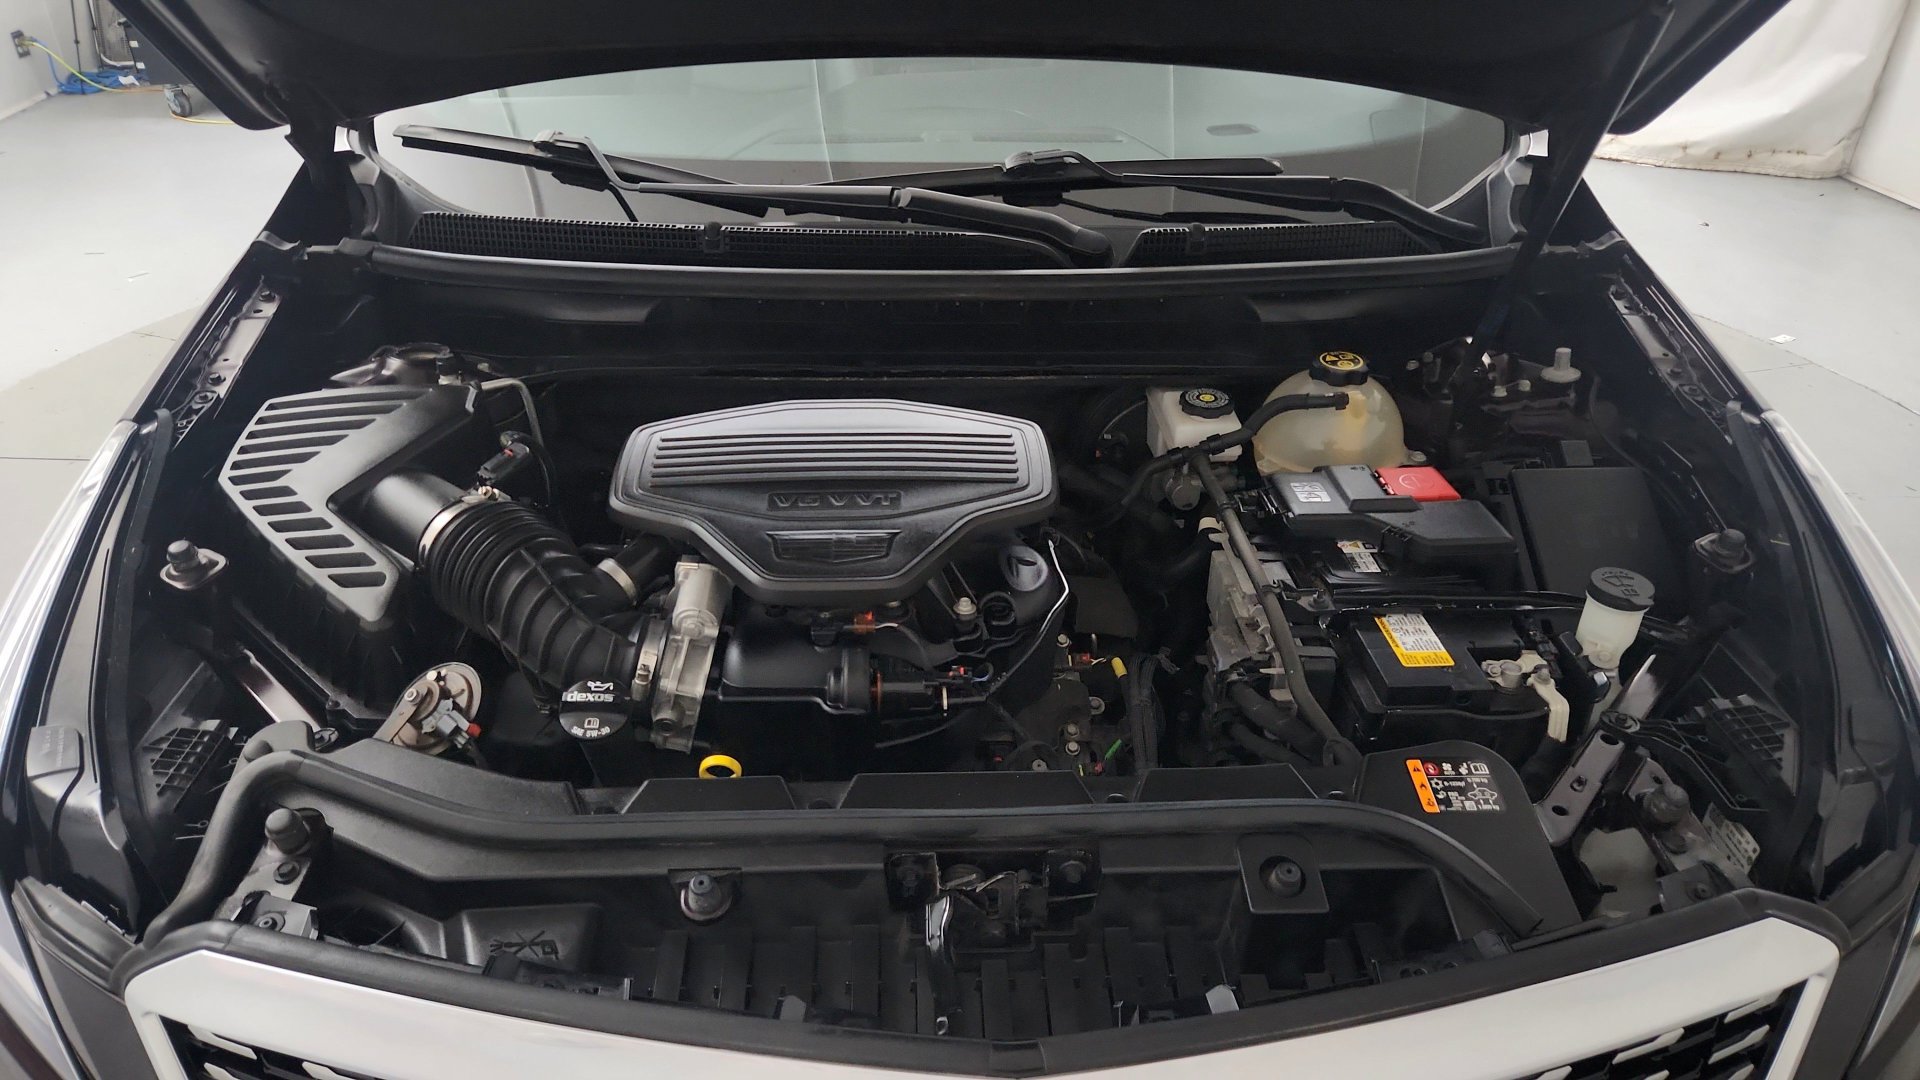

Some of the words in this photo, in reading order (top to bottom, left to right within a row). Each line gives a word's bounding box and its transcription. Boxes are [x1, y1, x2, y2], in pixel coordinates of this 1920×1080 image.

[773, 494, 820, 506] V6
[827, 493, 897, 506] VVT
[566, 691, 615, 702] dexos
[571, 726, 584, 736] SAE
[586, 726, 610, 737] 5W-30
